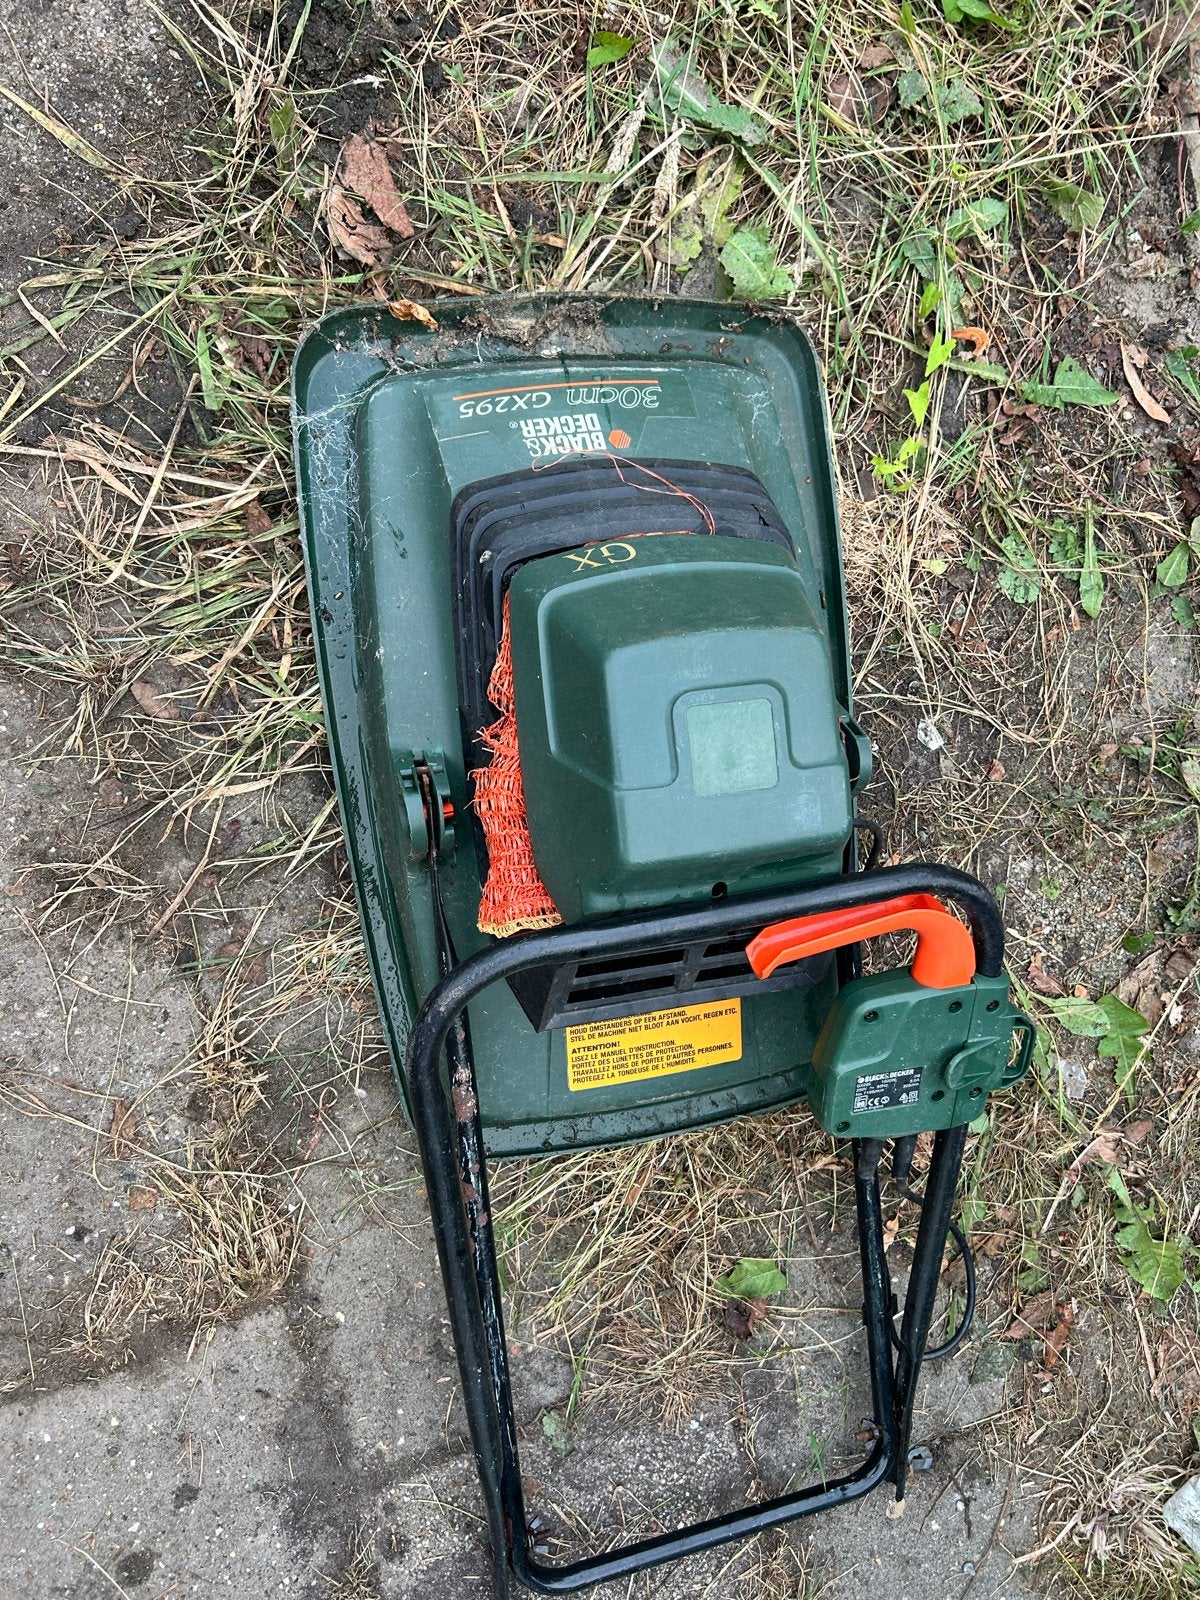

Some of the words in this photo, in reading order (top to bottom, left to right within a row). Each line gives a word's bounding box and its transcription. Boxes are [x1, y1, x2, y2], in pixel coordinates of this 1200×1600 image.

[459, 391, 551, 419] GX295
[567, 386, 662, 409] 30cm
[563, 542, 637, 573] GX
[570, 1028, 587, 1036] HOUD
[589, 1020, 632, 1032] OMSTANDERS
[644, 1015, 657, 1023] EEN
[658, 1010, 687, 1020] AFSTAND.
[570, 1035, 586, 1043] STEL
[588, 1032, 596, 1040] DE
[598, 1027, 627, 1038] MACHINE
[629, 1025, 642, 1033] NIET
[644, 1021, 664, 1031] BLOOT
[703, 1010, 723, 1020] REGEN
[571, 1041, 620, 1055] ATTENTION!
[571, 1055, 589, 1063] LISEZ
[600, 1048, 627, 1058] MANUEL
[571, 1060, 596, 1070] PORTEZ
[612, 1052, 644, 1063] LUNETTES
[655, 1043, 694, 1056] PROTECTION.
[572, 1073, 605, 1084] PROTEGEZ
[618, 1066, 650, 1077] TONDEUSE
[573, 1066, 610, 1077] TRAVAILLEZ
[612, 1063, 629, 1071] HORS
[641, 1056, 665, 1066] PORTEE
[666, 1049, 696, 1061] D'AUTRES
